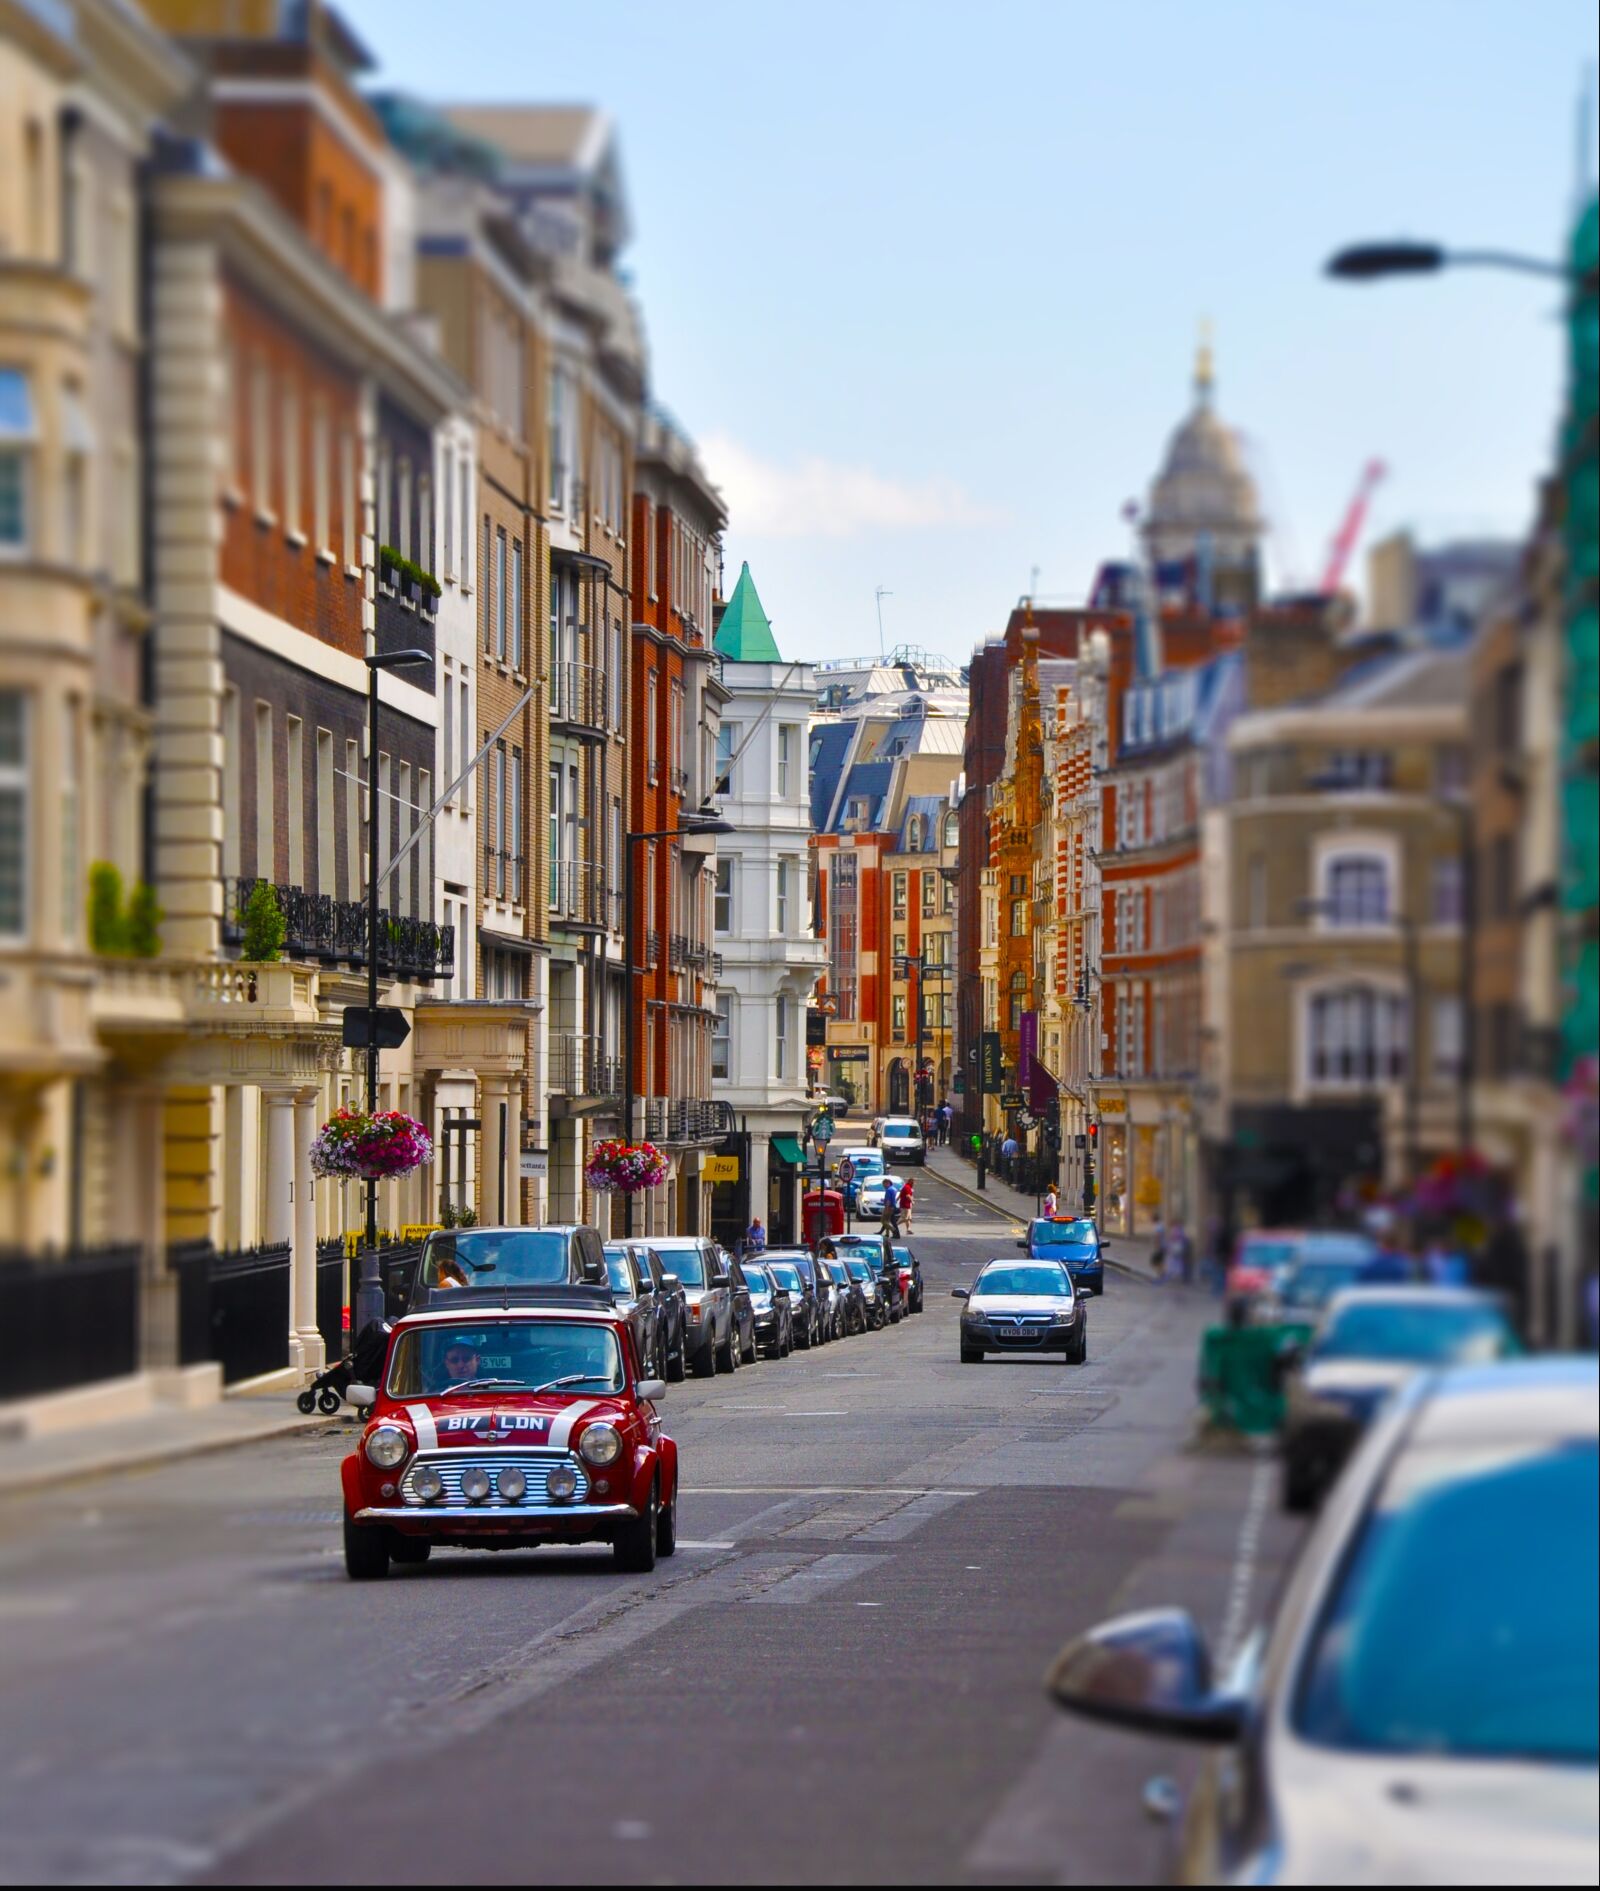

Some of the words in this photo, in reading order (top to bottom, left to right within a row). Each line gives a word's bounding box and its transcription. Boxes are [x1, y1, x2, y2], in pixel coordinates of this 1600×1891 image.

[714, 1161, 733, 1173] itsu
[489, 1357, 507, 1367] YUC
[447, 1416, 482, 1430] B17
[500, 1416, 544, 1430] LDN
